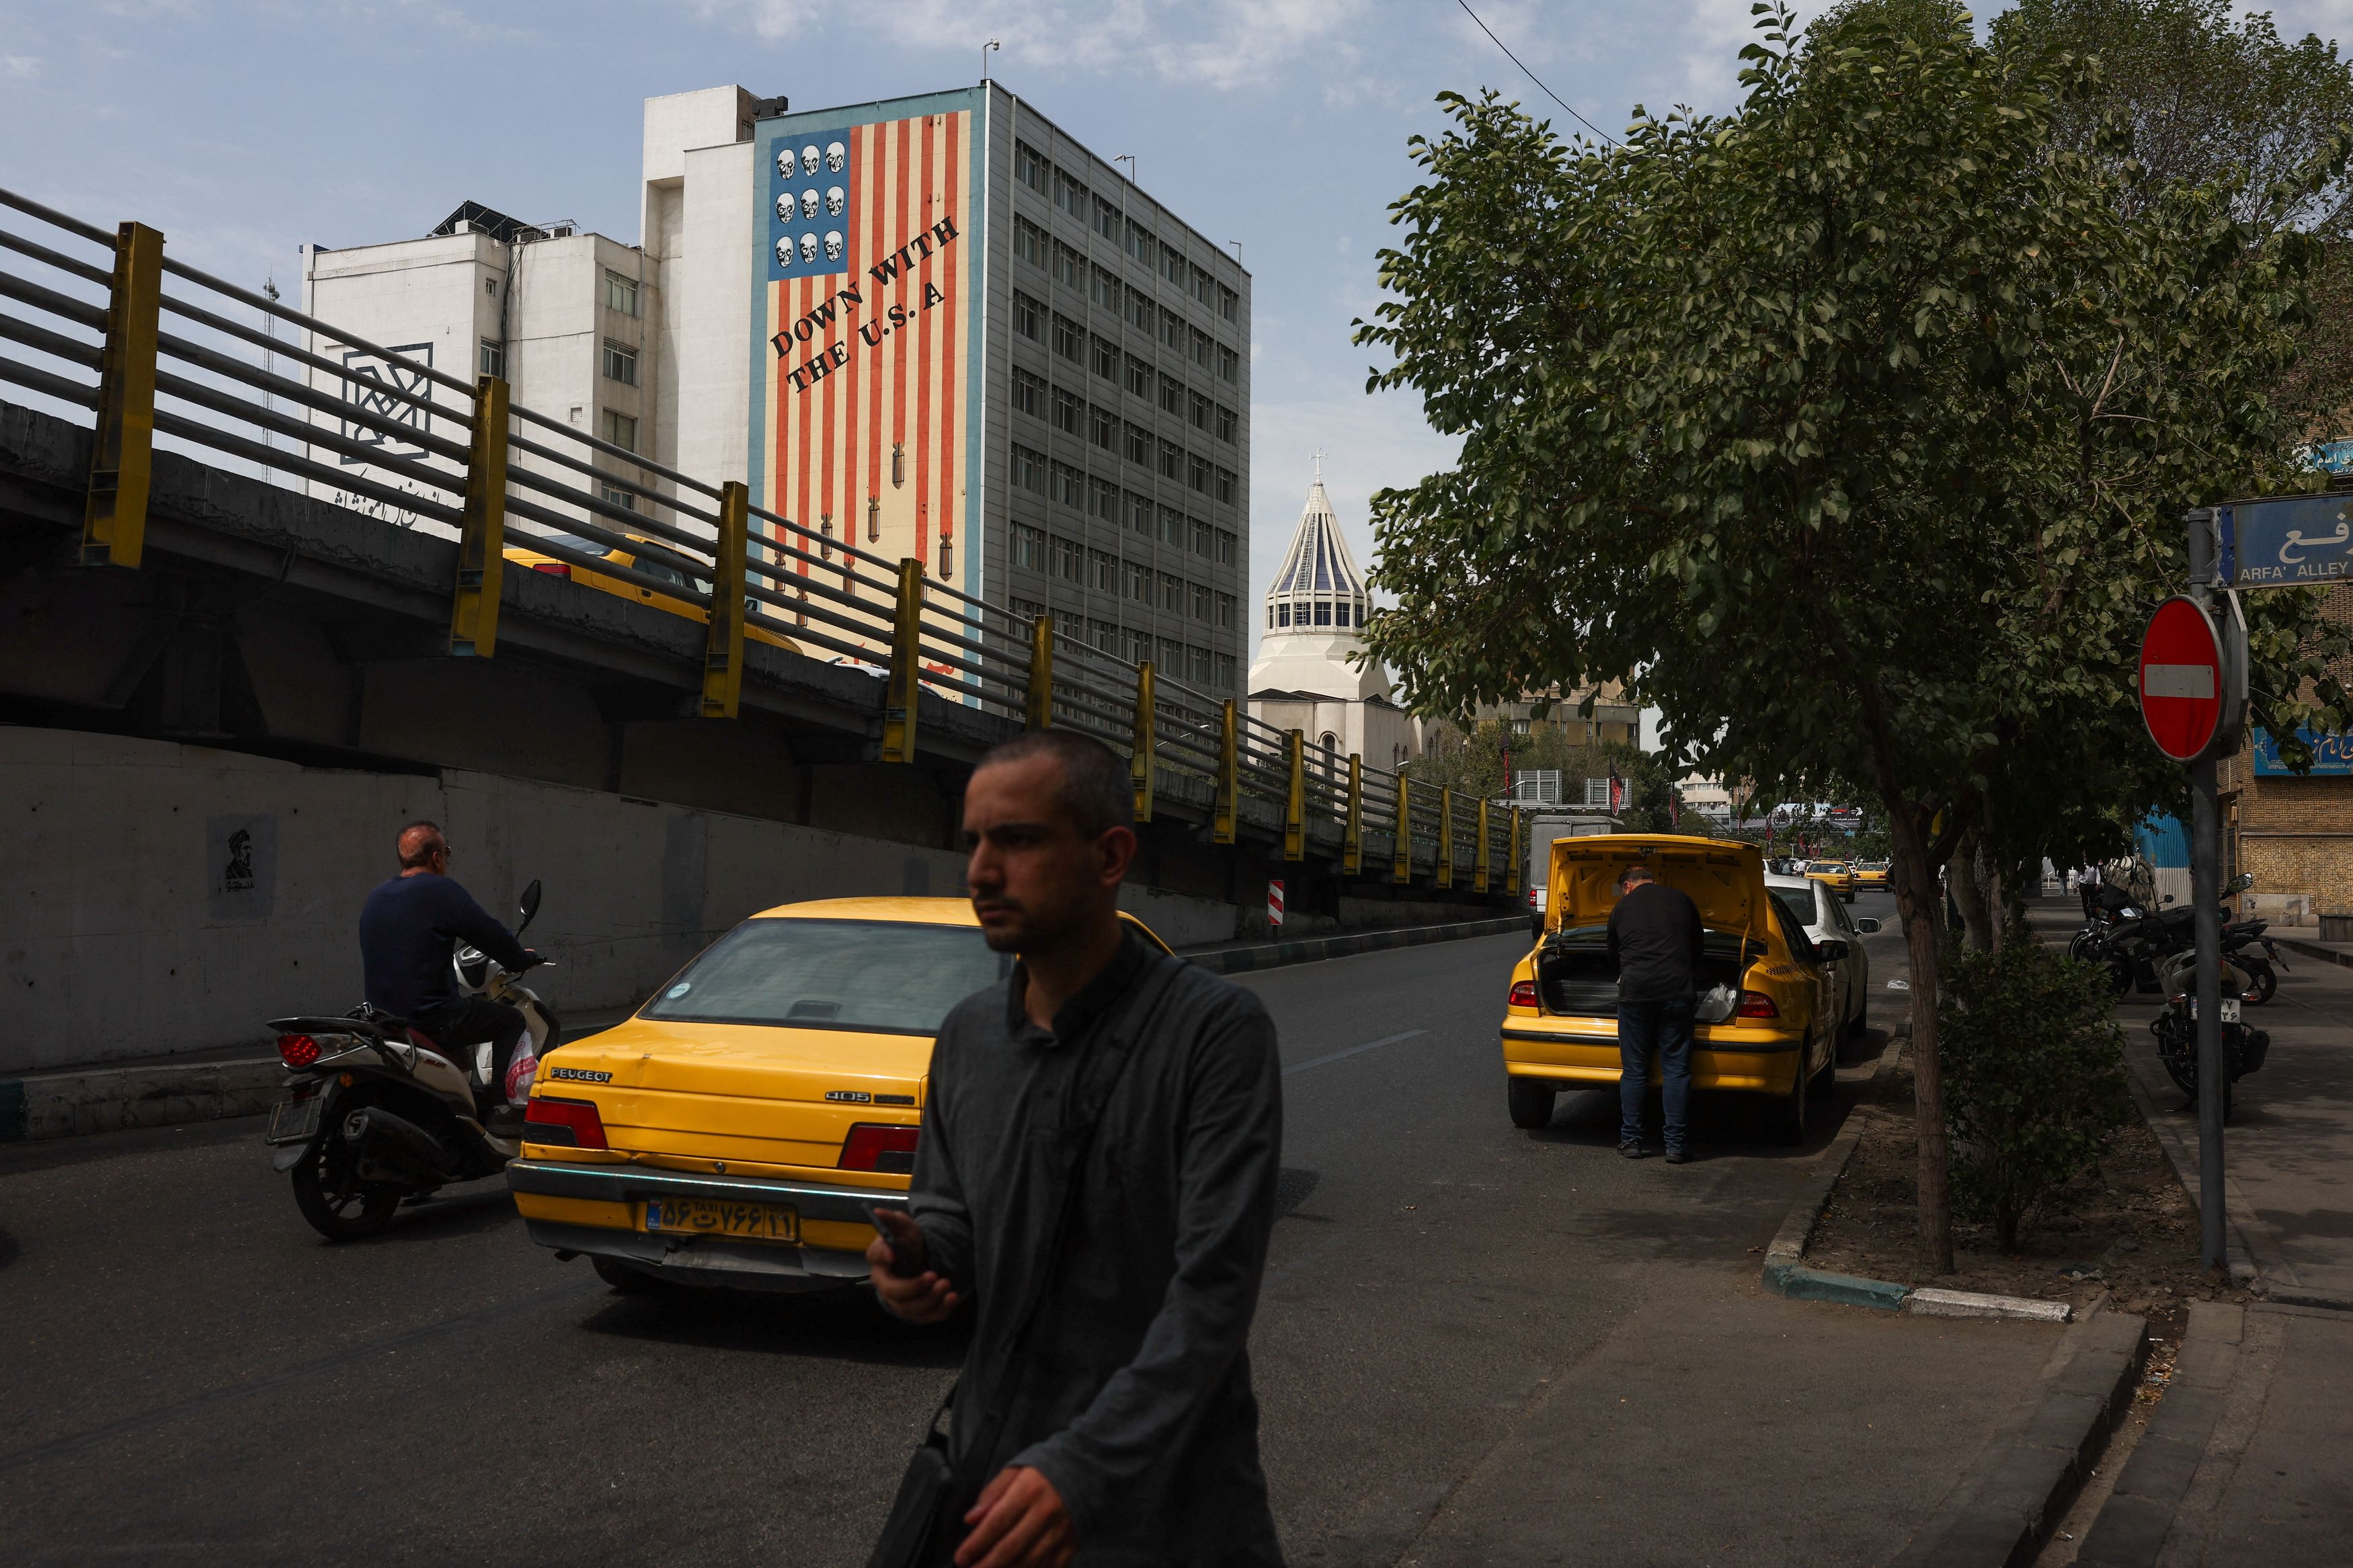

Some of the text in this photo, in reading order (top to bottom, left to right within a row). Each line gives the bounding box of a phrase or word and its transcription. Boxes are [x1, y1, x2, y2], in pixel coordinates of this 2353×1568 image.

[770, 216, 959, 359] DOWN WITH
[786, 340, 850, 394] THE
[2240, 561, 2348, 581] ARFA' ALLEY
[551, 1067, 611, 1081] PEUGEOT
[826, 1091, 870, 1102] 405
[693, 1203, 718, 1212] TAXI
[768, 1213, 791, 1237] ۱۱
